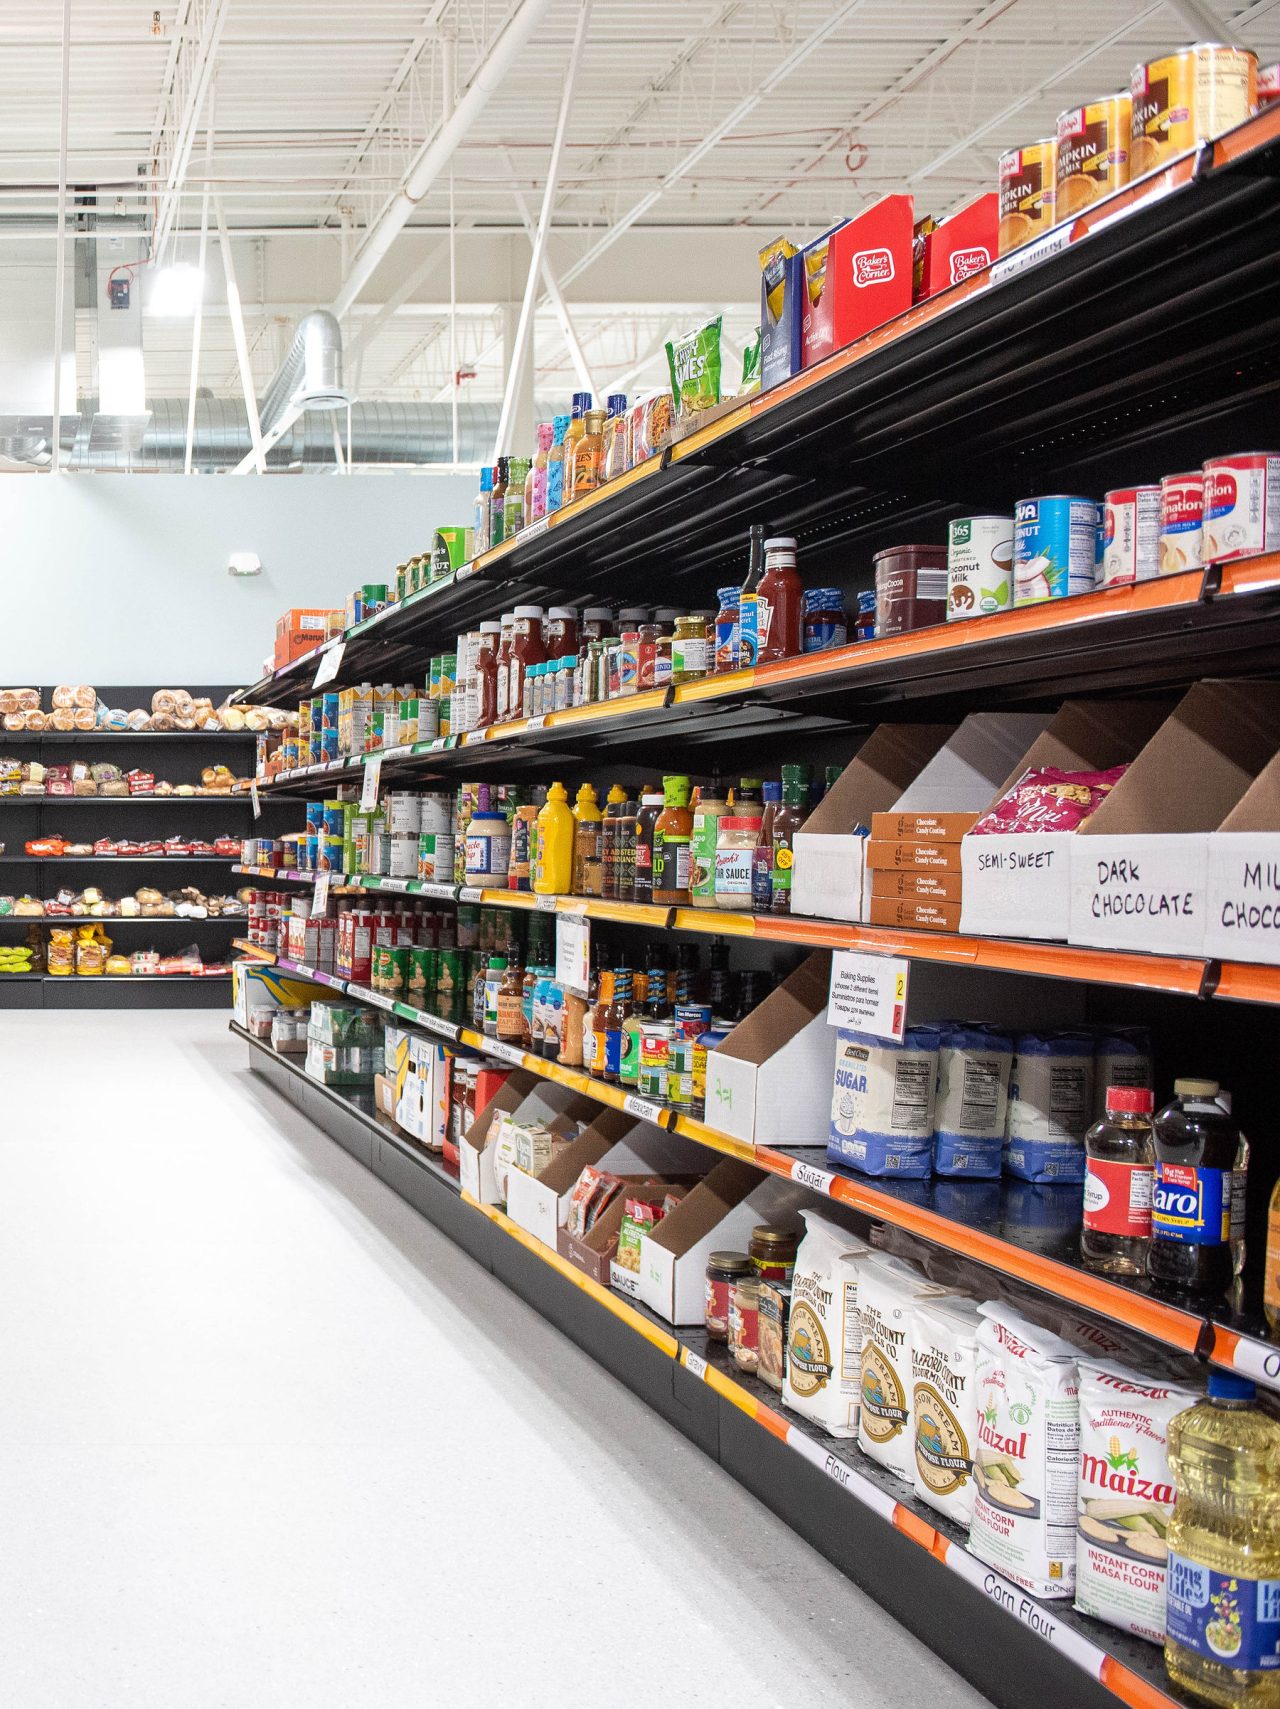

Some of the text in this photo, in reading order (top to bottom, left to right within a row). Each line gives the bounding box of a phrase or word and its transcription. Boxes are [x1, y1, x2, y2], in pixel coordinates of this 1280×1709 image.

[858, 255, 888, 270] Baker's
[955, 254, 985, 269] Baker's
[857, 267, 889, 284] Corner
[951, 525, 969, 538] 365
[951, 573, 969, 585] Milk
[1016, 801, 1069, 824] Mini
[916, 818, 938, 827] Chocolate
[915, 827, 929, 836] Candy
[929, 828, 947, 837] Coating
[916, 848, 938, 857] Chocolate
[978, 850, 1055, 872] SEMI-SWEET
[915, 857, 947, 867] Candy Coating
[726, 868, 750, 880] SAUCE
[1097, 859, 1140, 885] DARK
[916, 877, 938, 886] Chocolate
[915, 887, 947, 897] Candy Coating
[916, 906, 938, 915] Chocolate
[1092, 892, 1194, 919] CHOCOLATE
[915, 915, 947, 926] Candy Coating
[840, 970, 876, 985] Baking Supplies
[853, 985, 868, 994] different
[897, 979, 904, 997] 2
[832, 991, 856, 1003] Suministros
[834, 1002, 851, 1014] Товары
[859, 1008, 875, 1018] выпечки
[895, 1011, 901, 1029] 2
[898, 1060, 917, 1068] Nutrition
[835, 1069, 868, 1094] SUGAR
[796, 1164, 826, 1192] Sugar
[1165, 1166, 1174, 1178] 0g
[1087, 1189, 1103, 1201] Syrup
[866, 1304, 883, 1319] THE
[807, 1316, 824, 1359] CREAM
[876, 1320, 906, 1347] COUNTY
[885, 1341, 899, 1363] CO.
[930, 1346, 949, 1363] THE
[687, 1351, 706, 1377] Gravy
[808, 1362, 828, 1374] FLOUR
[874, 1356, 897, 1403] CREAM
[941, 1363, 966, 1392] COUNTY
[945, 1388, 960, 1409] CO.
[881, 1405, 904, 1419] FLOUR
[1101, 1407, 1153, 1426] AUTHENTIC
[933, 1399, 960, 1452] CREAM
[1047, 1421, 1073, 1429] Nutrition
[1088, 1417, 1167, 1446] Traditional Flavor
[824, 1453, 852, 1487] Flour
[941, 1454, 968, 1470] FLOUR
[987, 1518, 1011, 1538] FLOUR
[991, 1511, 1016, 1529] CORN
[1087, 1548, 1166, 1584] INSTANT CORN
[1169, 1554, 1202, 1586] Long
[1015, 1573, 1036, 1590] FREE
[1092, 1562, 1160, 1594] MASA FLOUR
[1169, 1576, 1198, 1603] Life
[983, 1572, 1057, 1642] Corn Flour
[1130, 1622, 1167, 1643] GLUTEN
